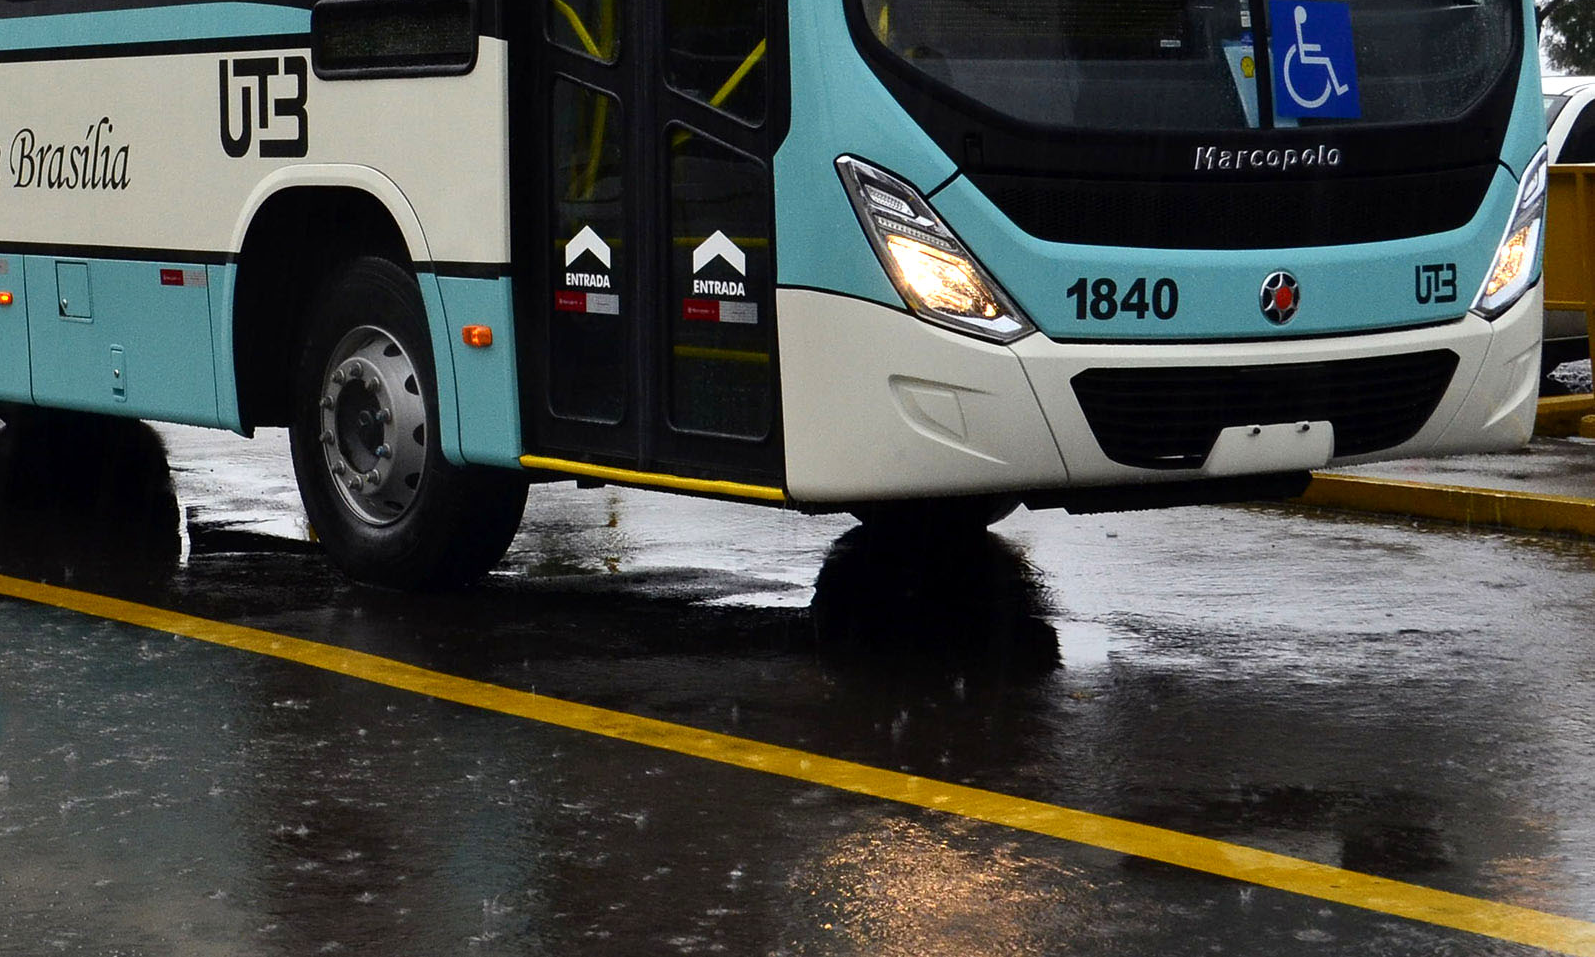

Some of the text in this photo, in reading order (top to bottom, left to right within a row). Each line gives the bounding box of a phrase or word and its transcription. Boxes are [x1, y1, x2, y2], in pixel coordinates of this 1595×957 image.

[218, 55, 309, 158] UTB
[10, 116, 132, 190] Brasília
[1194, 144, 1341, 171] Marcopolo
[565, 272, 611, 288] ENTRADA
[693, 279, 746, 297] ENTRADA
[1066, 277, 1179, 320] 1840
[1415, 262, 1457, 305] UTB
